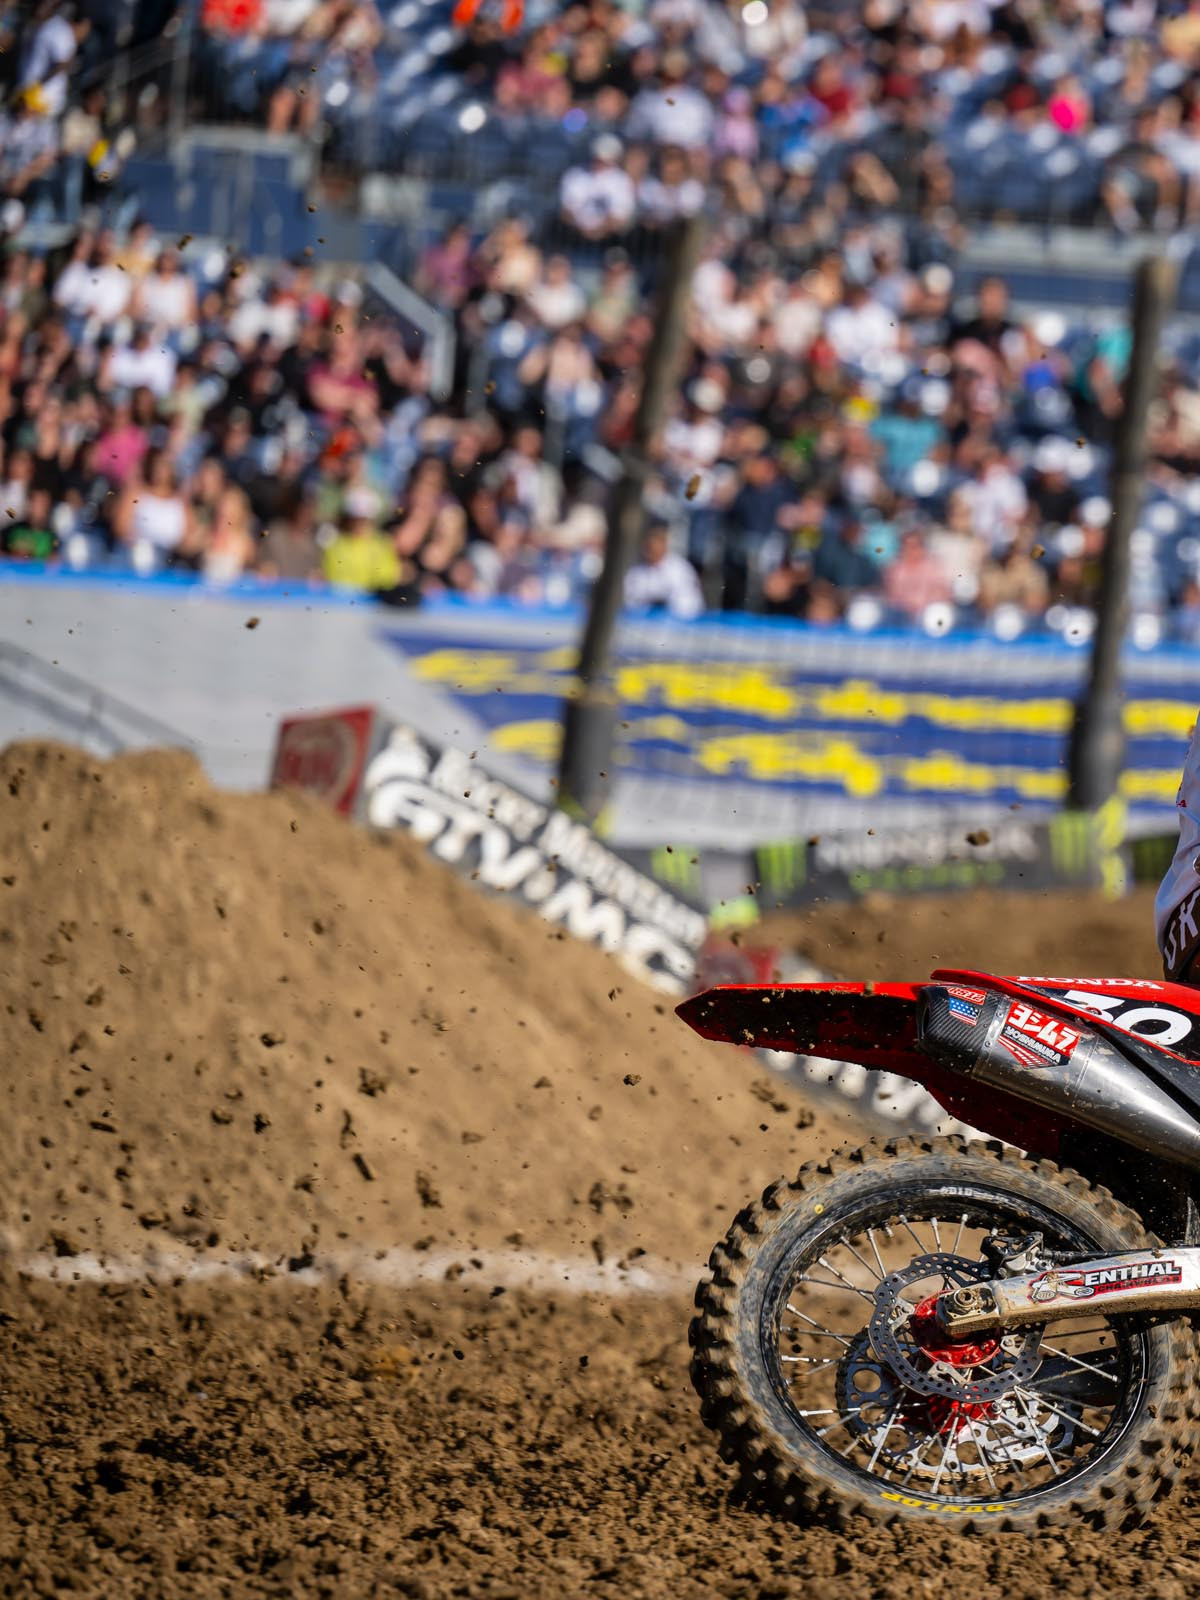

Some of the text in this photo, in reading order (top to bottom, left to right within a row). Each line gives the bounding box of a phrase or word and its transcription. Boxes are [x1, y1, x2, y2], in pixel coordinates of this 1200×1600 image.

[1016, 975, 1164, 990] HONDA
[1008, 1003, 1077, 1051] ヨシムラ
[1004, 1026, 1061, 1064] YOSHIMURA
[881, 1491, 1006, 1513] DUNLOP
